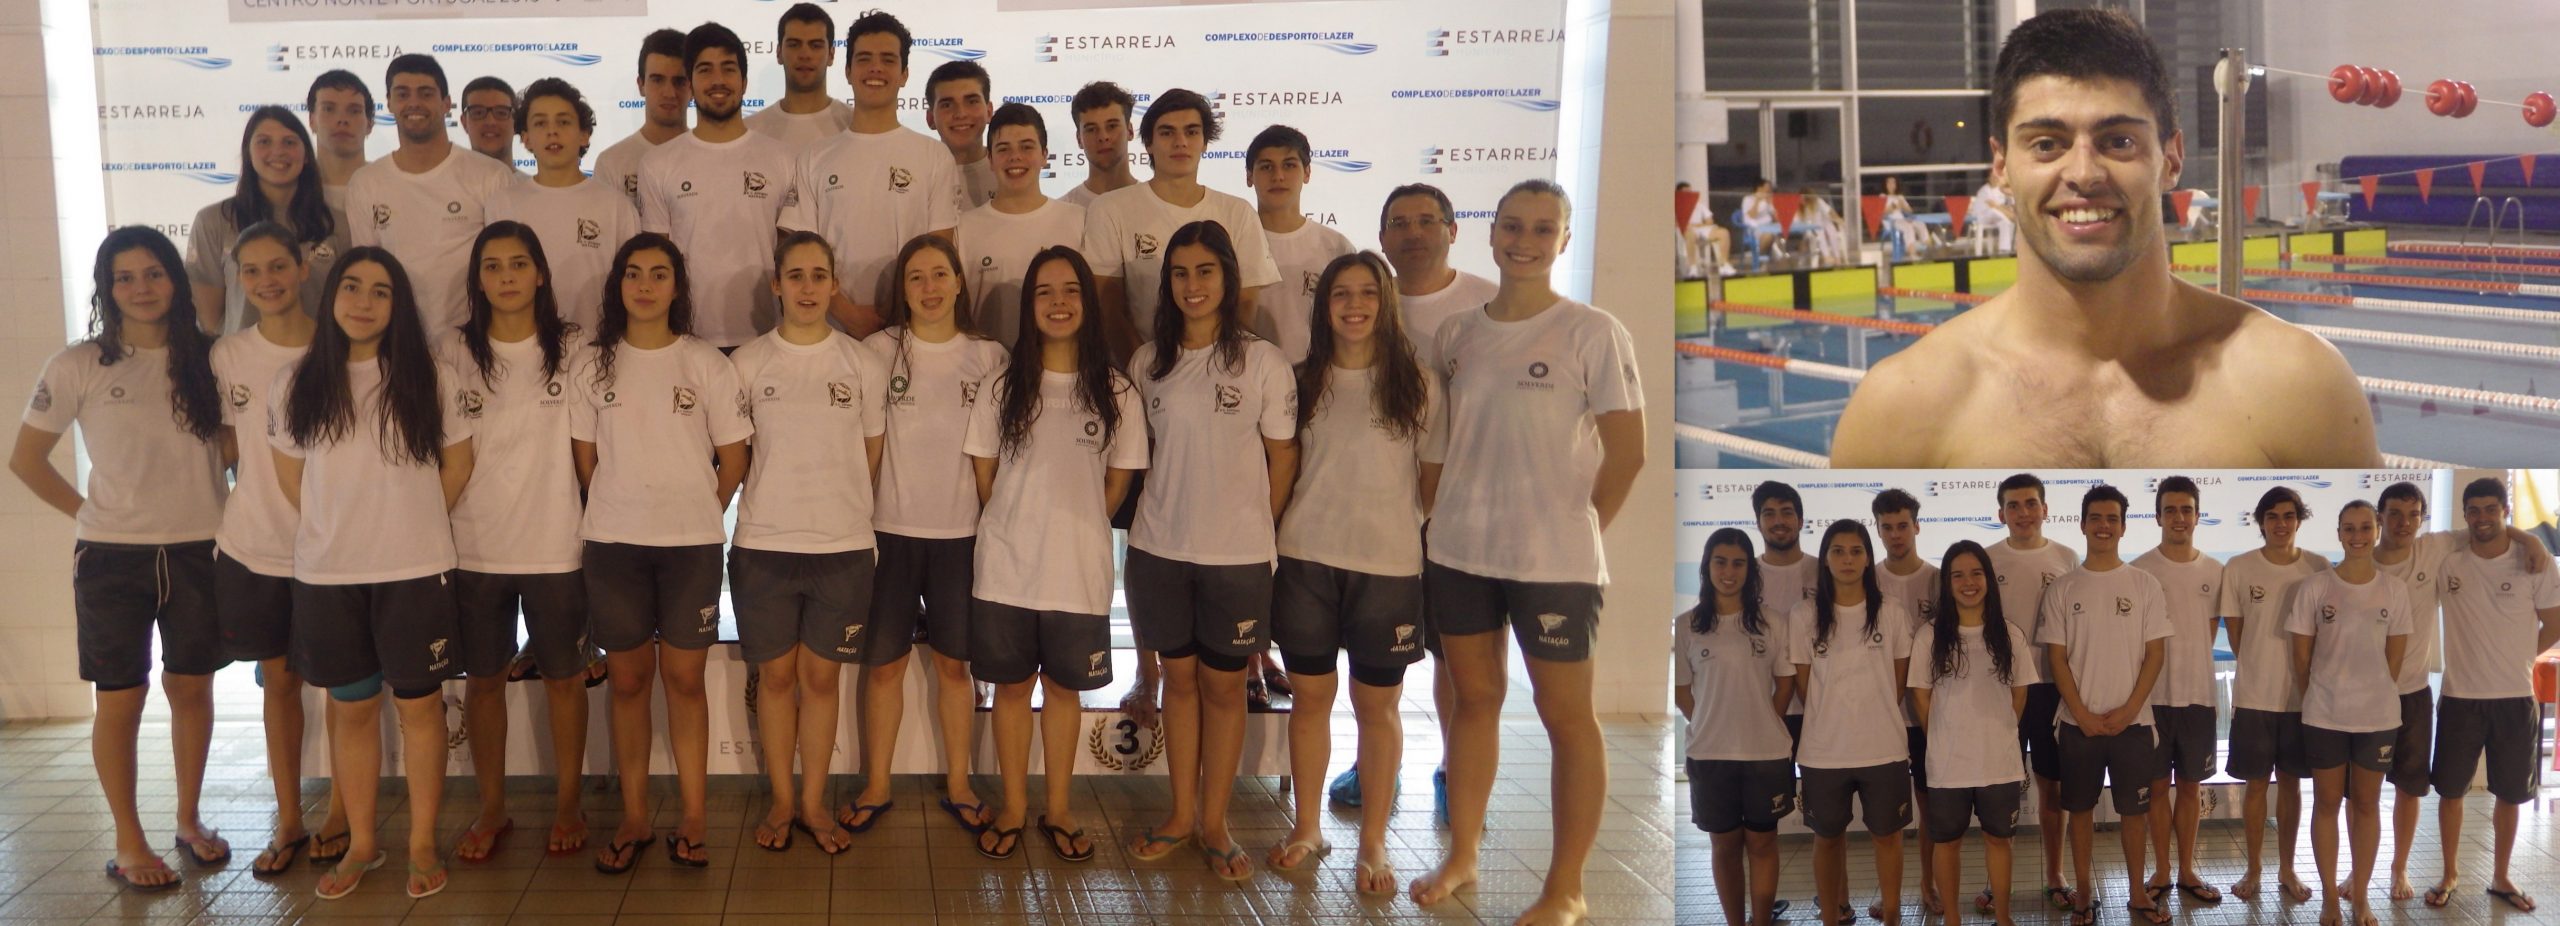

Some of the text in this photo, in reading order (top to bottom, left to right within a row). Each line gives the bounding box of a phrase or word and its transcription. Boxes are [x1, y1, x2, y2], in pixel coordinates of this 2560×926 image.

[1065, 35, 1176, 49] ESTARREJA
[1456, 29, 1566, 43] ESTARREJA
[296, 45, 403, 59] ESTARREJA
[1232, 91, 1343, 106] ESTARREJA
[98, 105, 205, 119] ESTARREJA
[1450, 147, 1558, 161] ESTARREJA
[2374, 473, 2433, 482] ESTARREJA
[1115, 719, 1139, 755] 3
